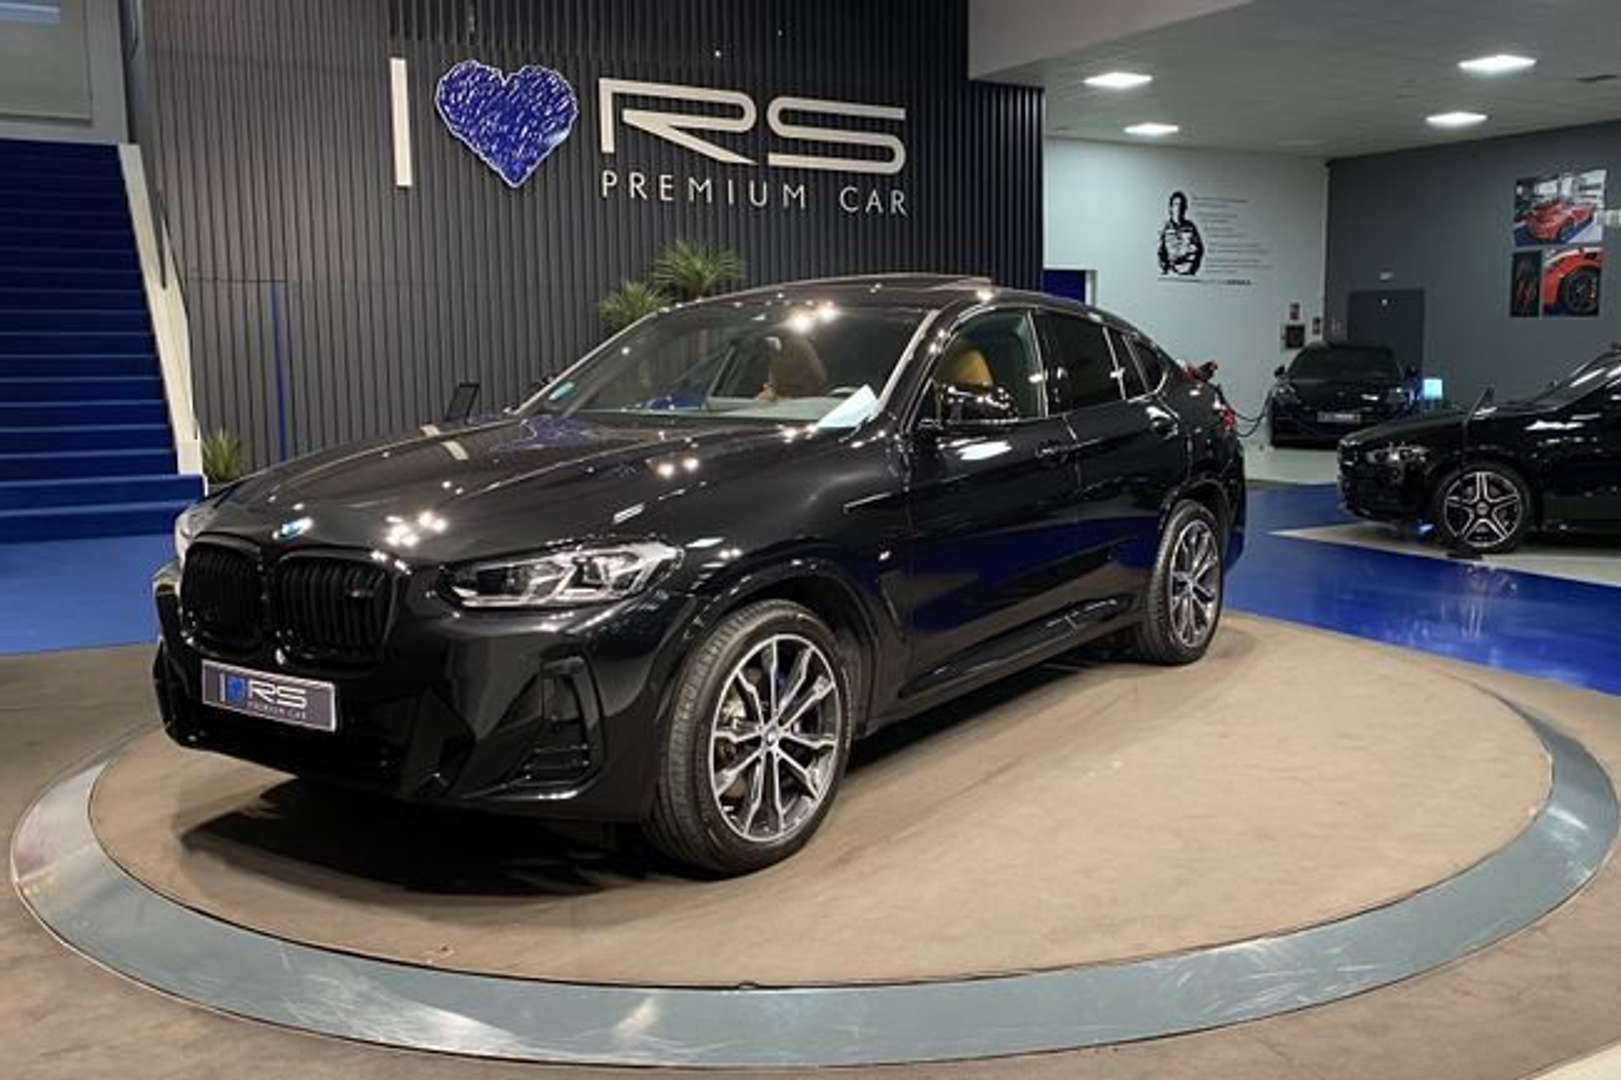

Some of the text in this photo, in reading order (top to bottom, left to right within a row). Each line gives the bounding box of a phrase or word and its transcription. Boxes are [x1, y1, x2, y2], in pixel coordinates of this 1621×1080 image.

[599, 77, 907, 175] RS
[601, 170, 908, 217] PREMIUM CAR
[247, 679, 307, 709] RS
